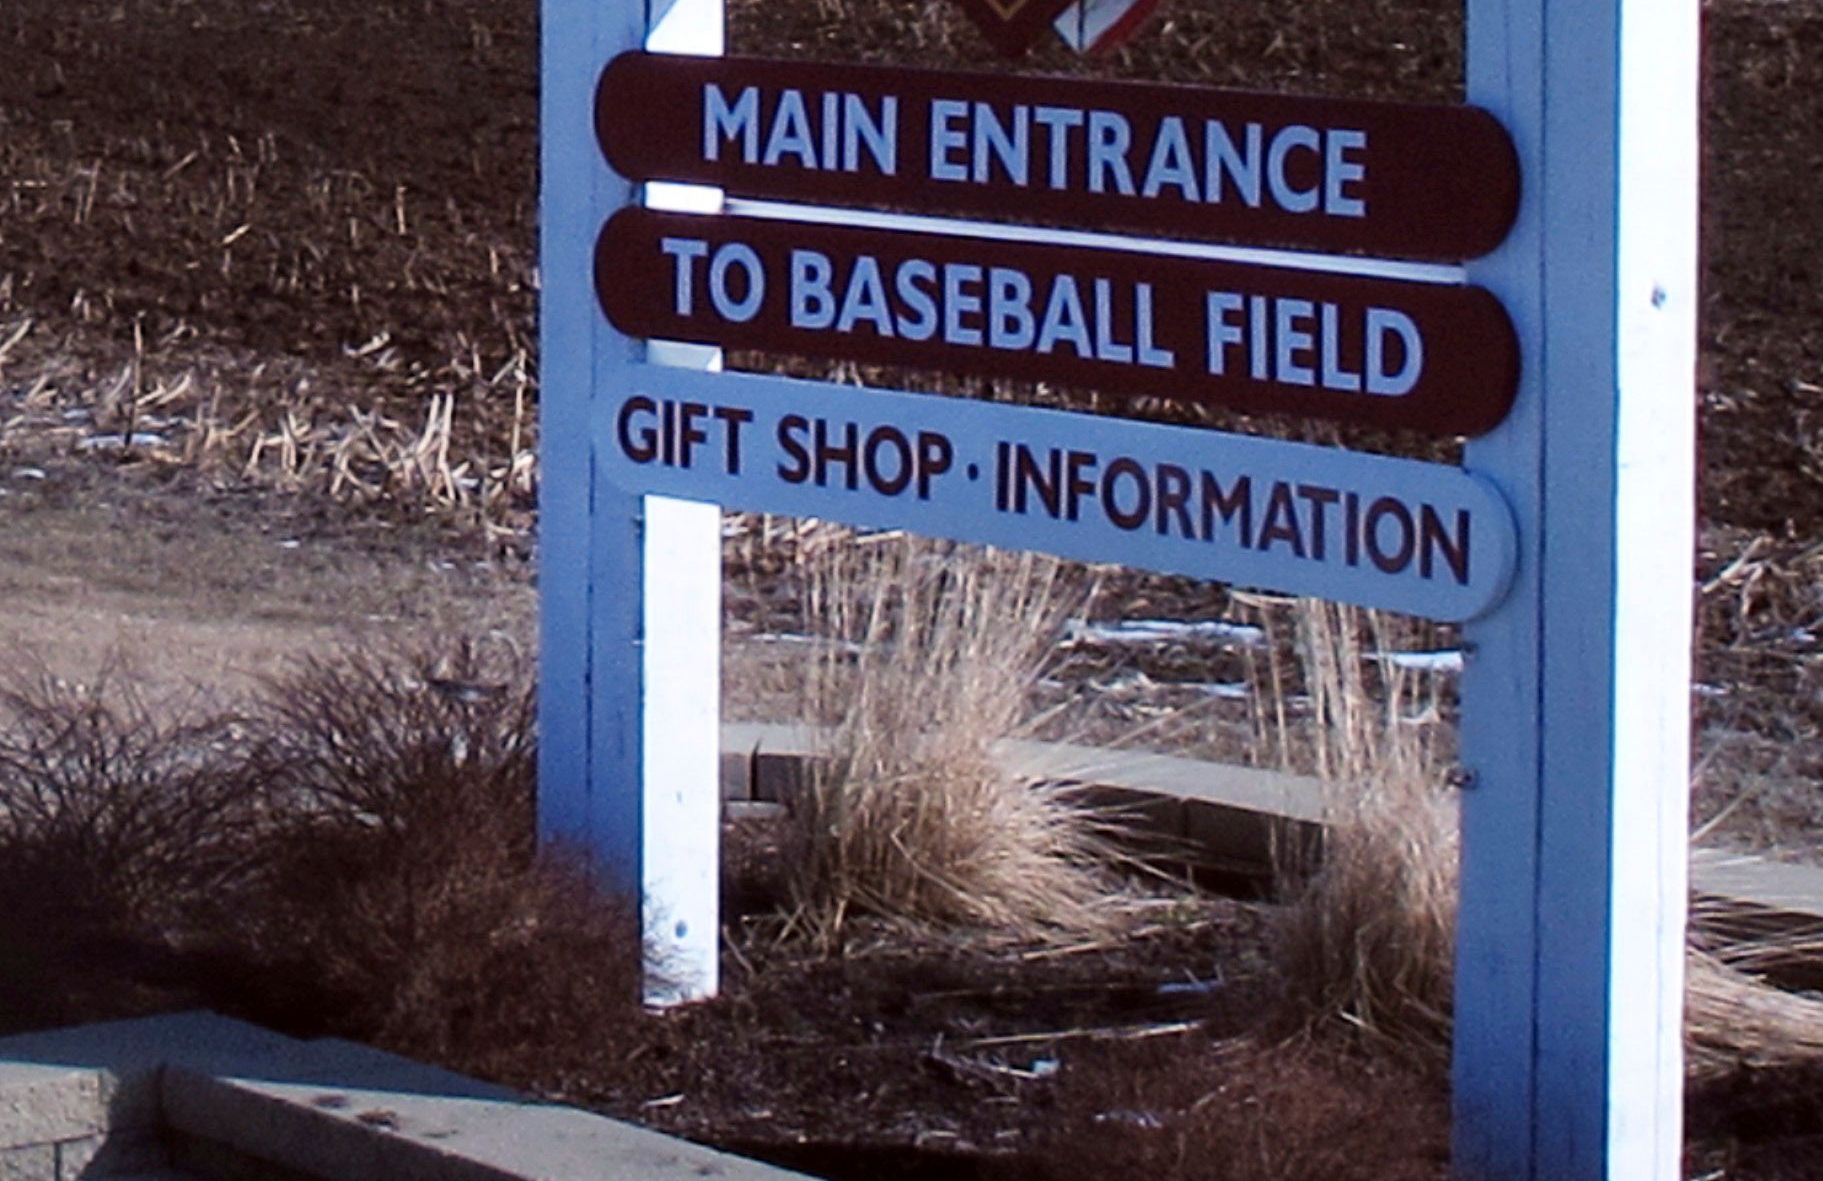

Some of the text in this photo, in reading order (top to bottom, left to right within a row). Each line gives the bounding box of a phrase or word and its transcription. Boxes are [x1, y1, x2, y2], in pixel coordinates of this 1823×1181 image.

[702, 83, 1367, 219] MAIN ENTRANCE
[662, 236, 1423, 397] TO BASEBALL FIELD
[616, 396, 1470, 587] GIFT SHOP INFORMATION
